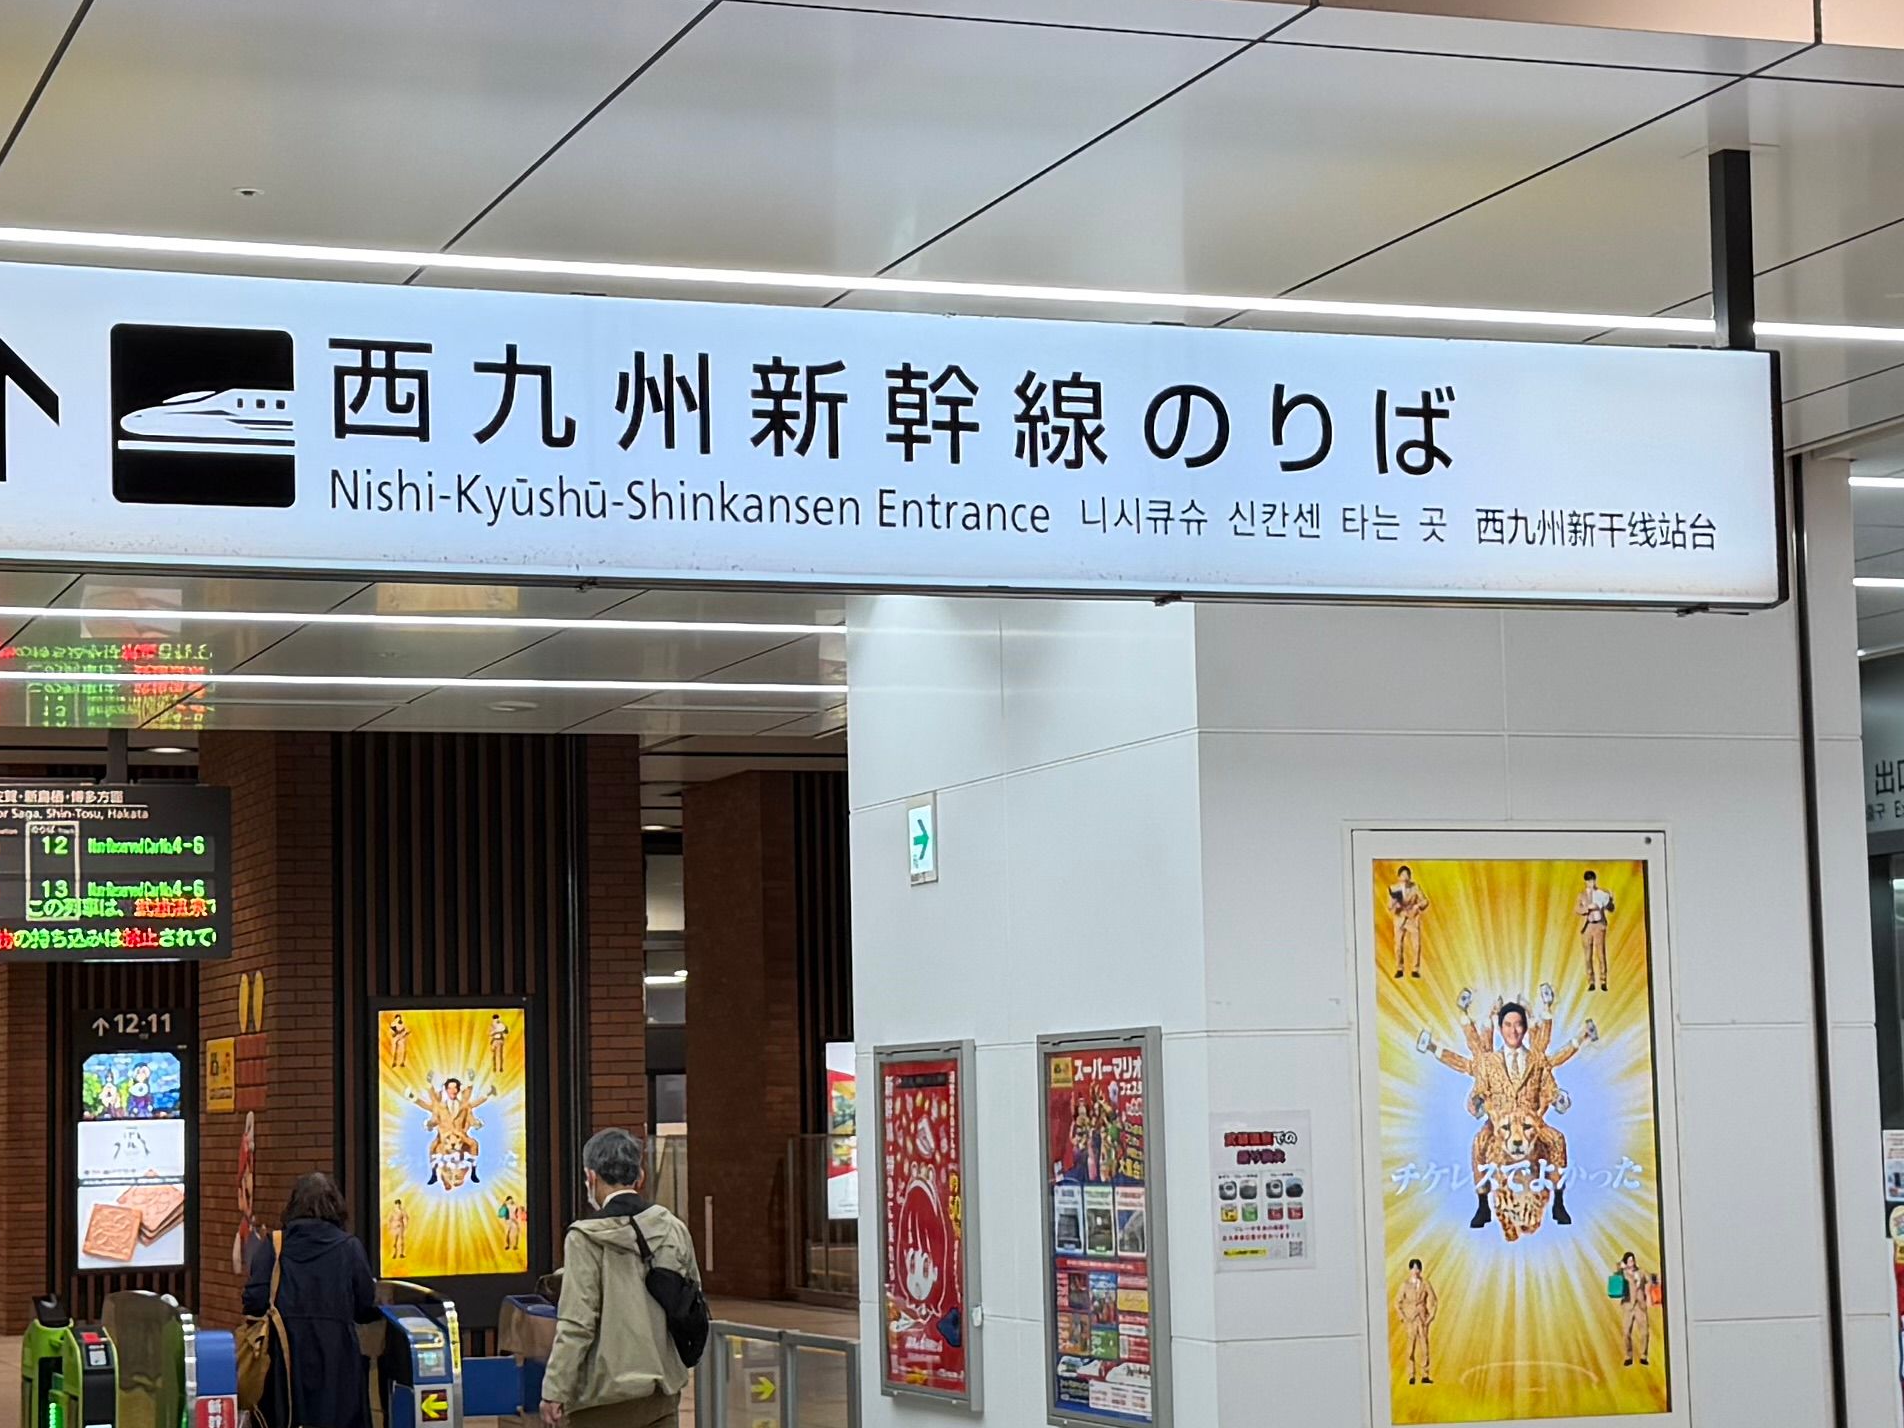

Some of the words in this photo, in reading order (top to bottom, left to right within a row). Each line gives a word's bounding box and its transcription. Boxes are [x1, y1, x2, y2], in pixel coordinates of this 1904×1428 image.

[328, 337, 1456, 478] 西九州新幹線のりば
[330, 467, 861, 530] Nishi-Kyūshū-Shinkansen
[878, 487, 1051, 535] Entrance
[1079, 494, 1209, 539] 니시큐슈
[1228, 497, 1322, 542] 신칸센
[1342, 502, 1401, 545] 타는
[1421, 504, 1447, 545] 곳
[1475, 506, 1718, 553] 西九州新干线站台
[107, 809, 150, 820] Hakata
[42, 835, 68, 854] 12
[41, 879, 69, 898] 13
[1074, 1055, 1142, 1082] スーパーマリオ
[1391, 1156, 1643, 1196] チケレスでよかった
